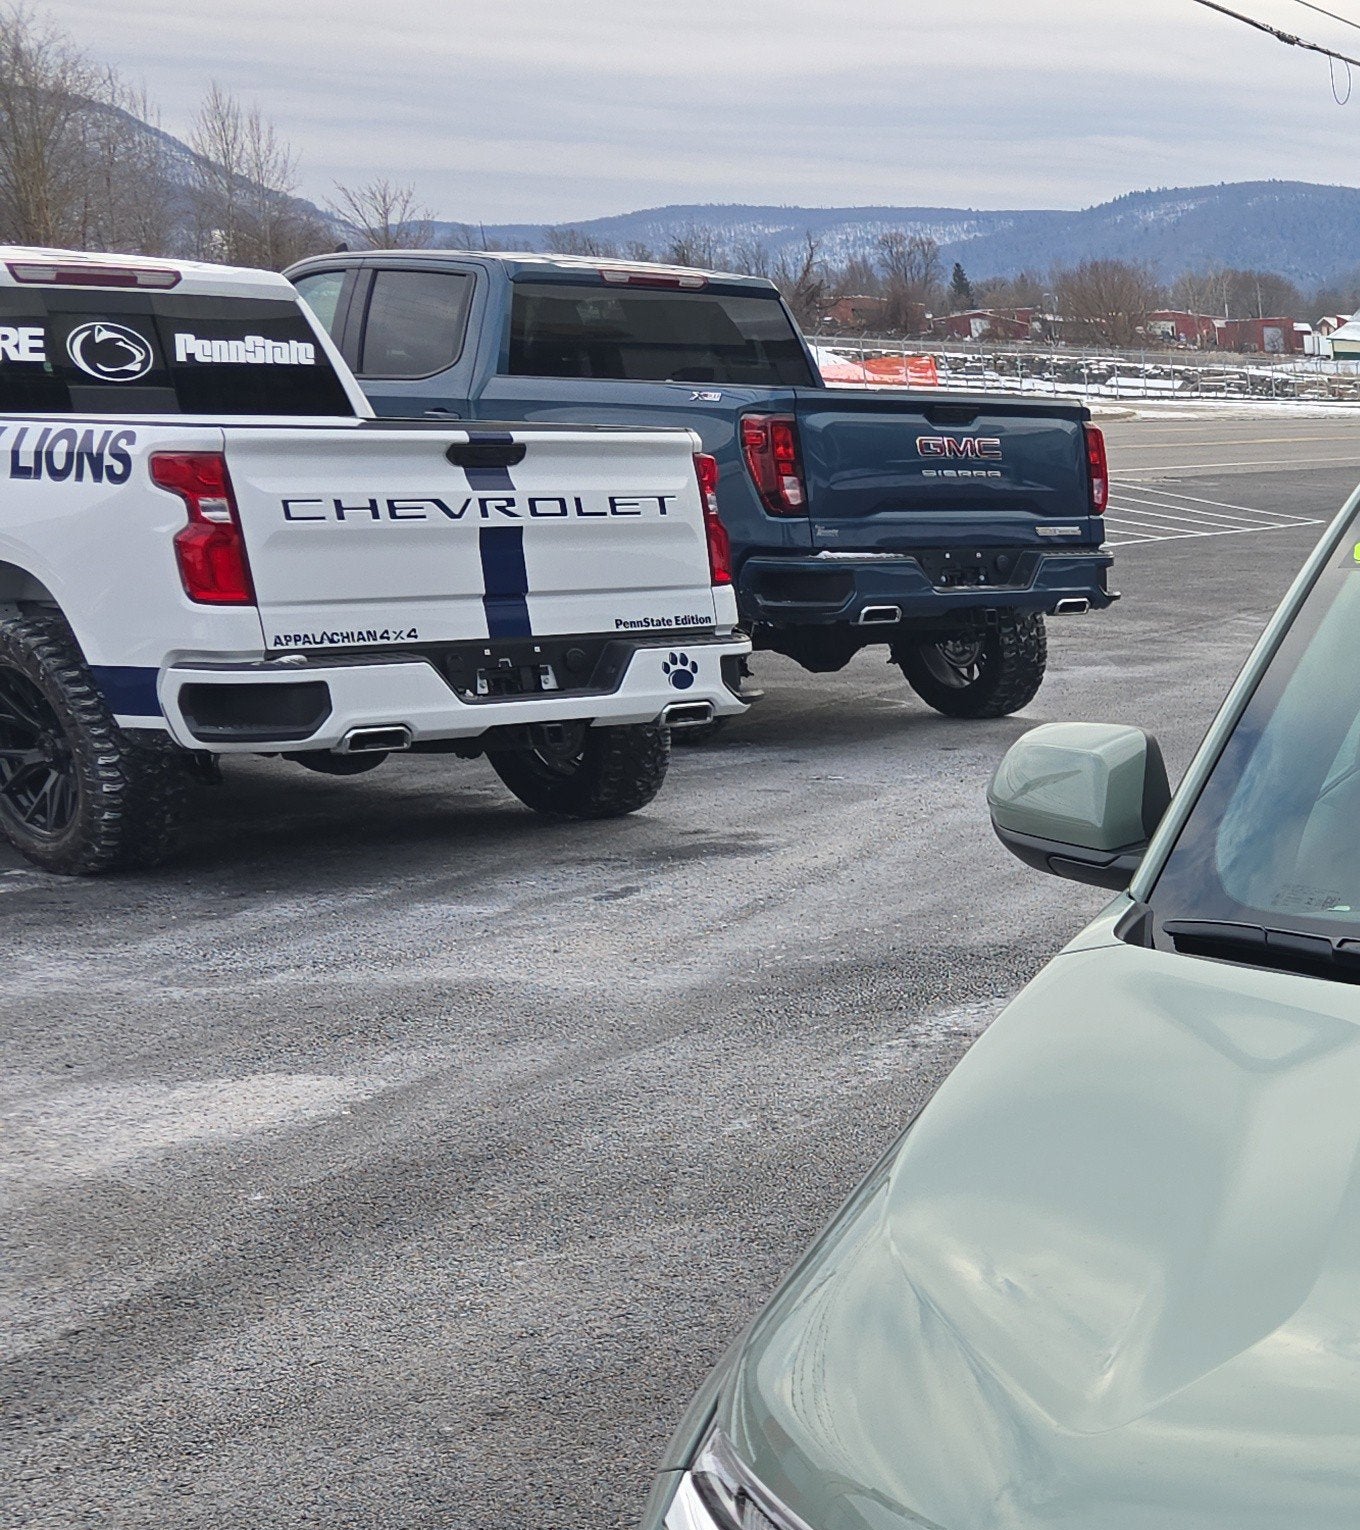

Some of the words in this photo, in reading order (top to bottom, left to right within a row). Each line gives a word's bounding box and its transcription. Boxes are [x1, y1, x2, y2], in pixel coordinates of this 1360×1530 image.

[174, 333, 315, 365] PennState
[9, 427, 137, 485] LIONS
[916, 436, 1003, 460] GMC
[281, 495, 677, 521] CHEVROLET
[614, 617, 673, 629] PennState
[674, 614, 712, 626] Edition
